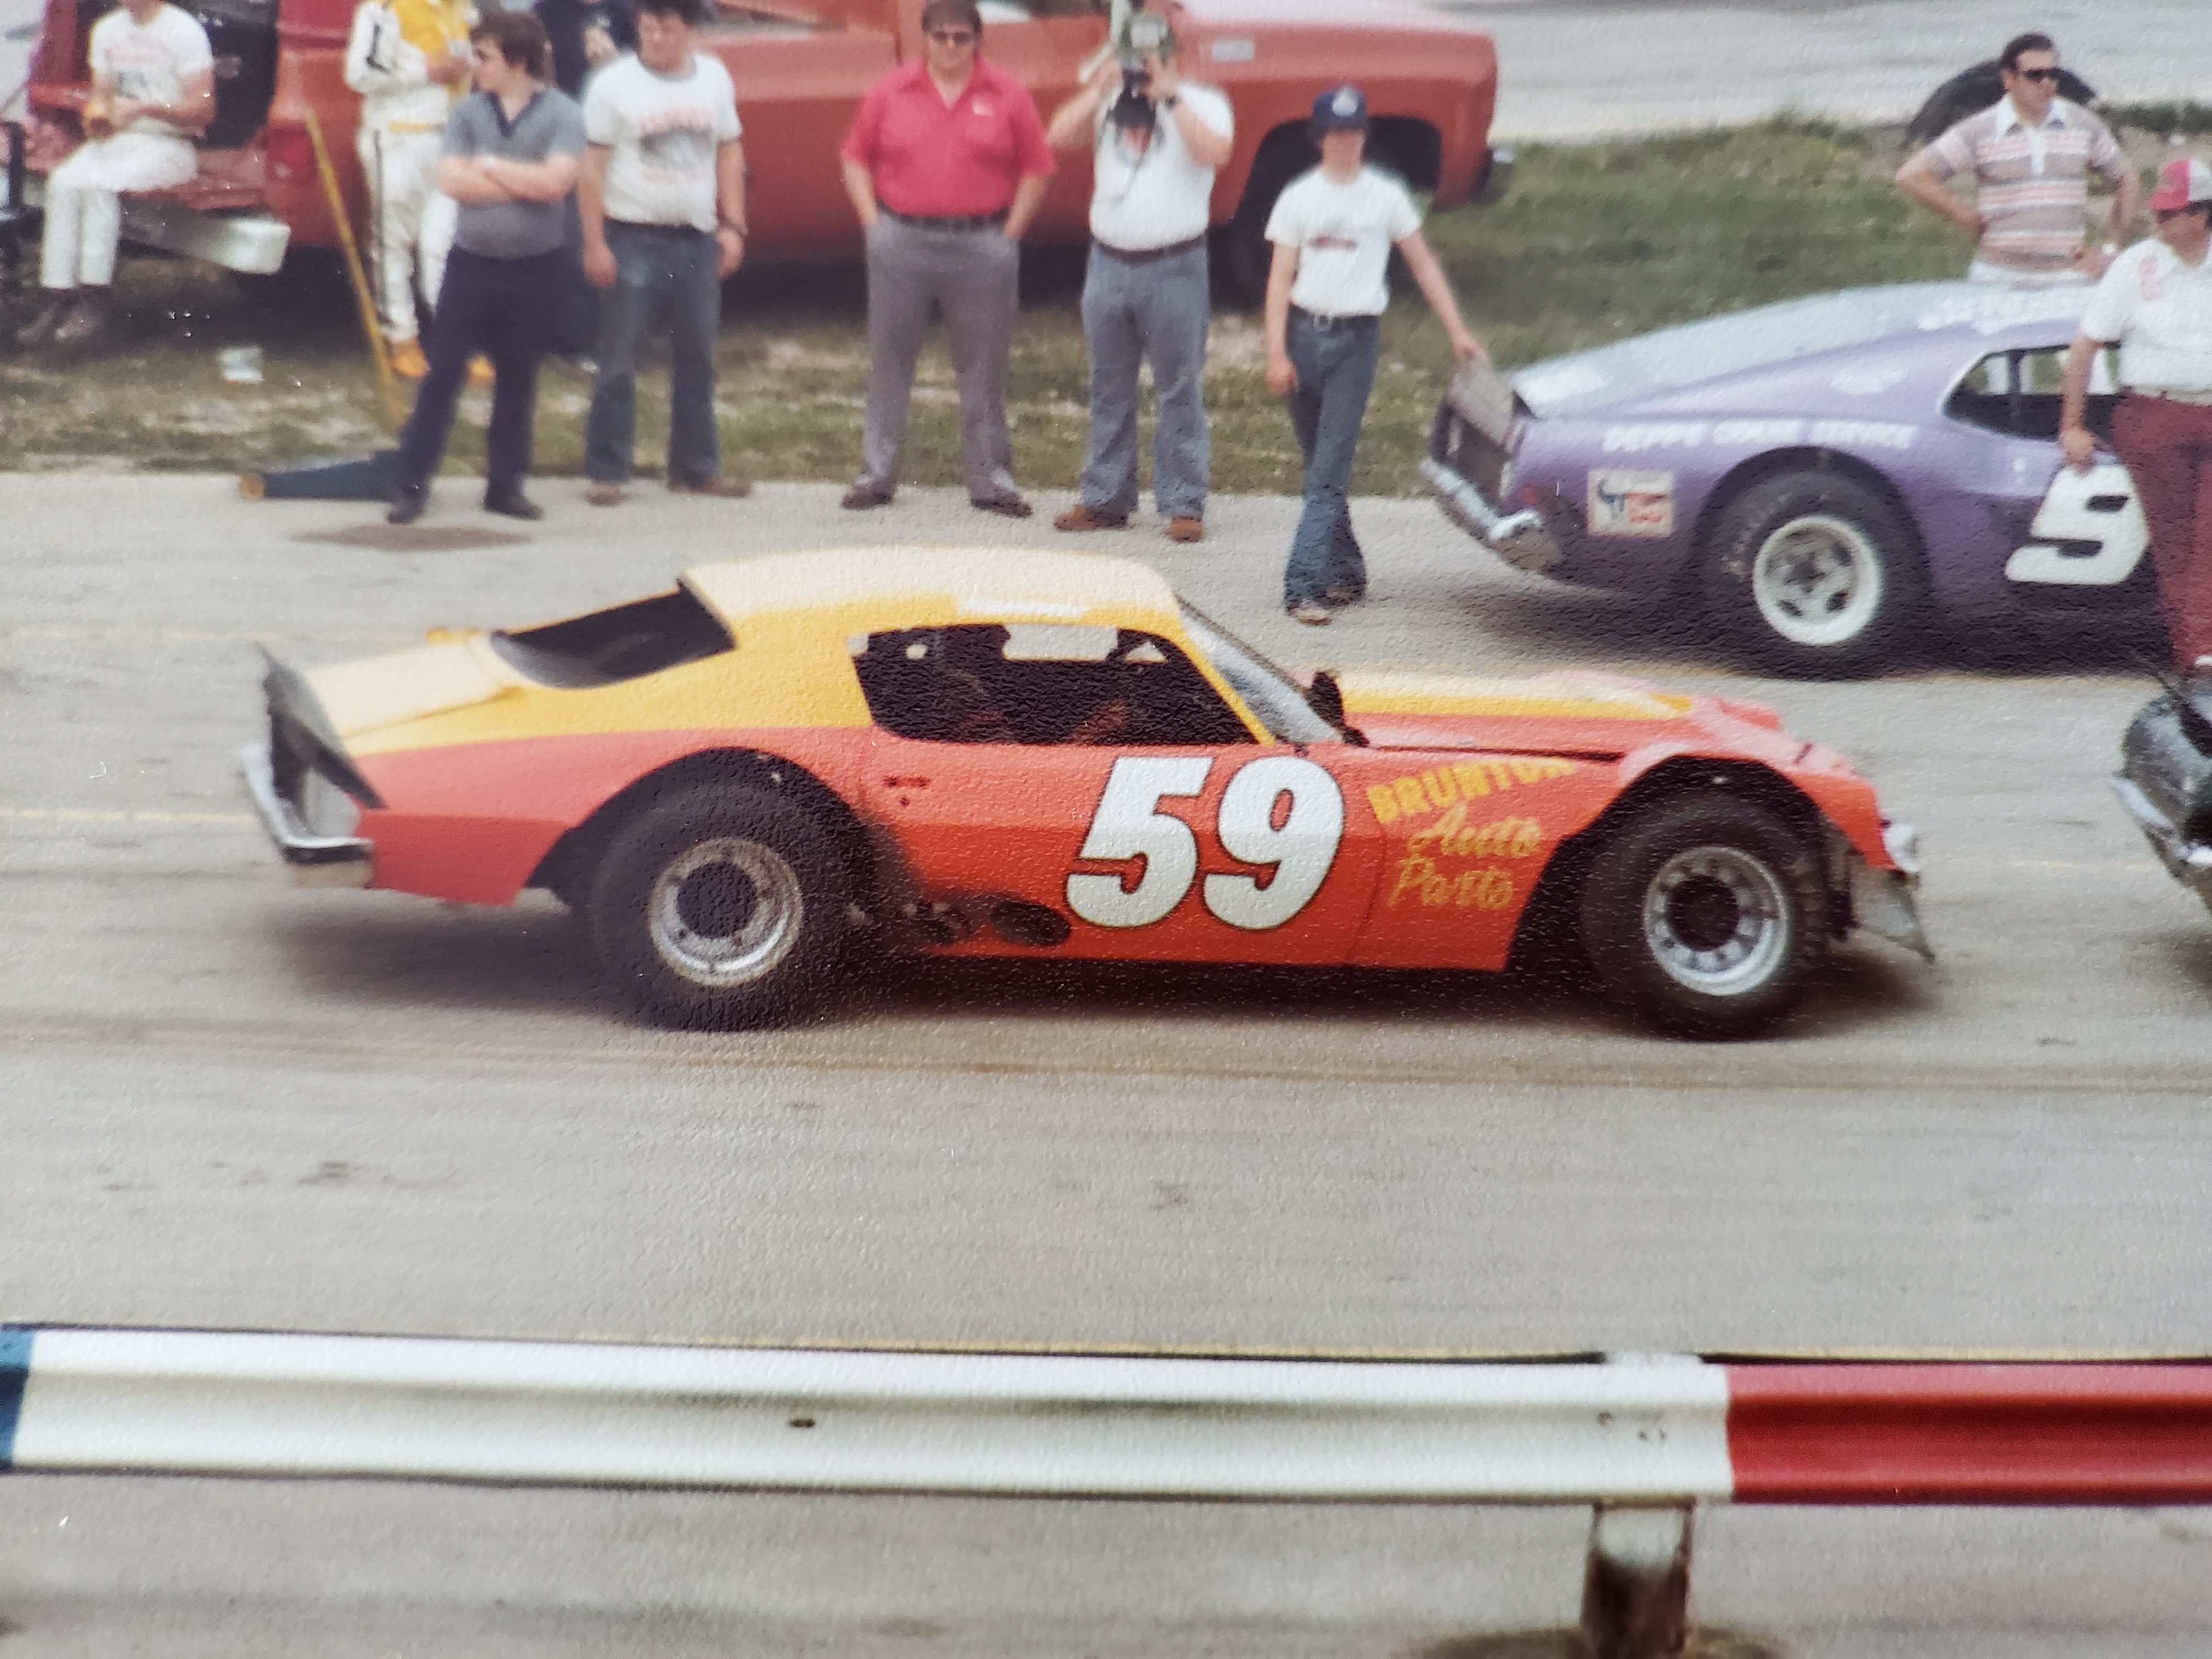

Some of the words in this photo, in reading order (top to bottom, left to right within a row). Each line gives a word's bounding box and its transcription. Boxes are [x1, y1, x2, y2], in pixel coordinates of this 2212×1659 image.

[1066, 755, 1345, 929] 59
[1407, 800, 1543, 859] Auto
[1386, 854, 1514, 909] Parts
